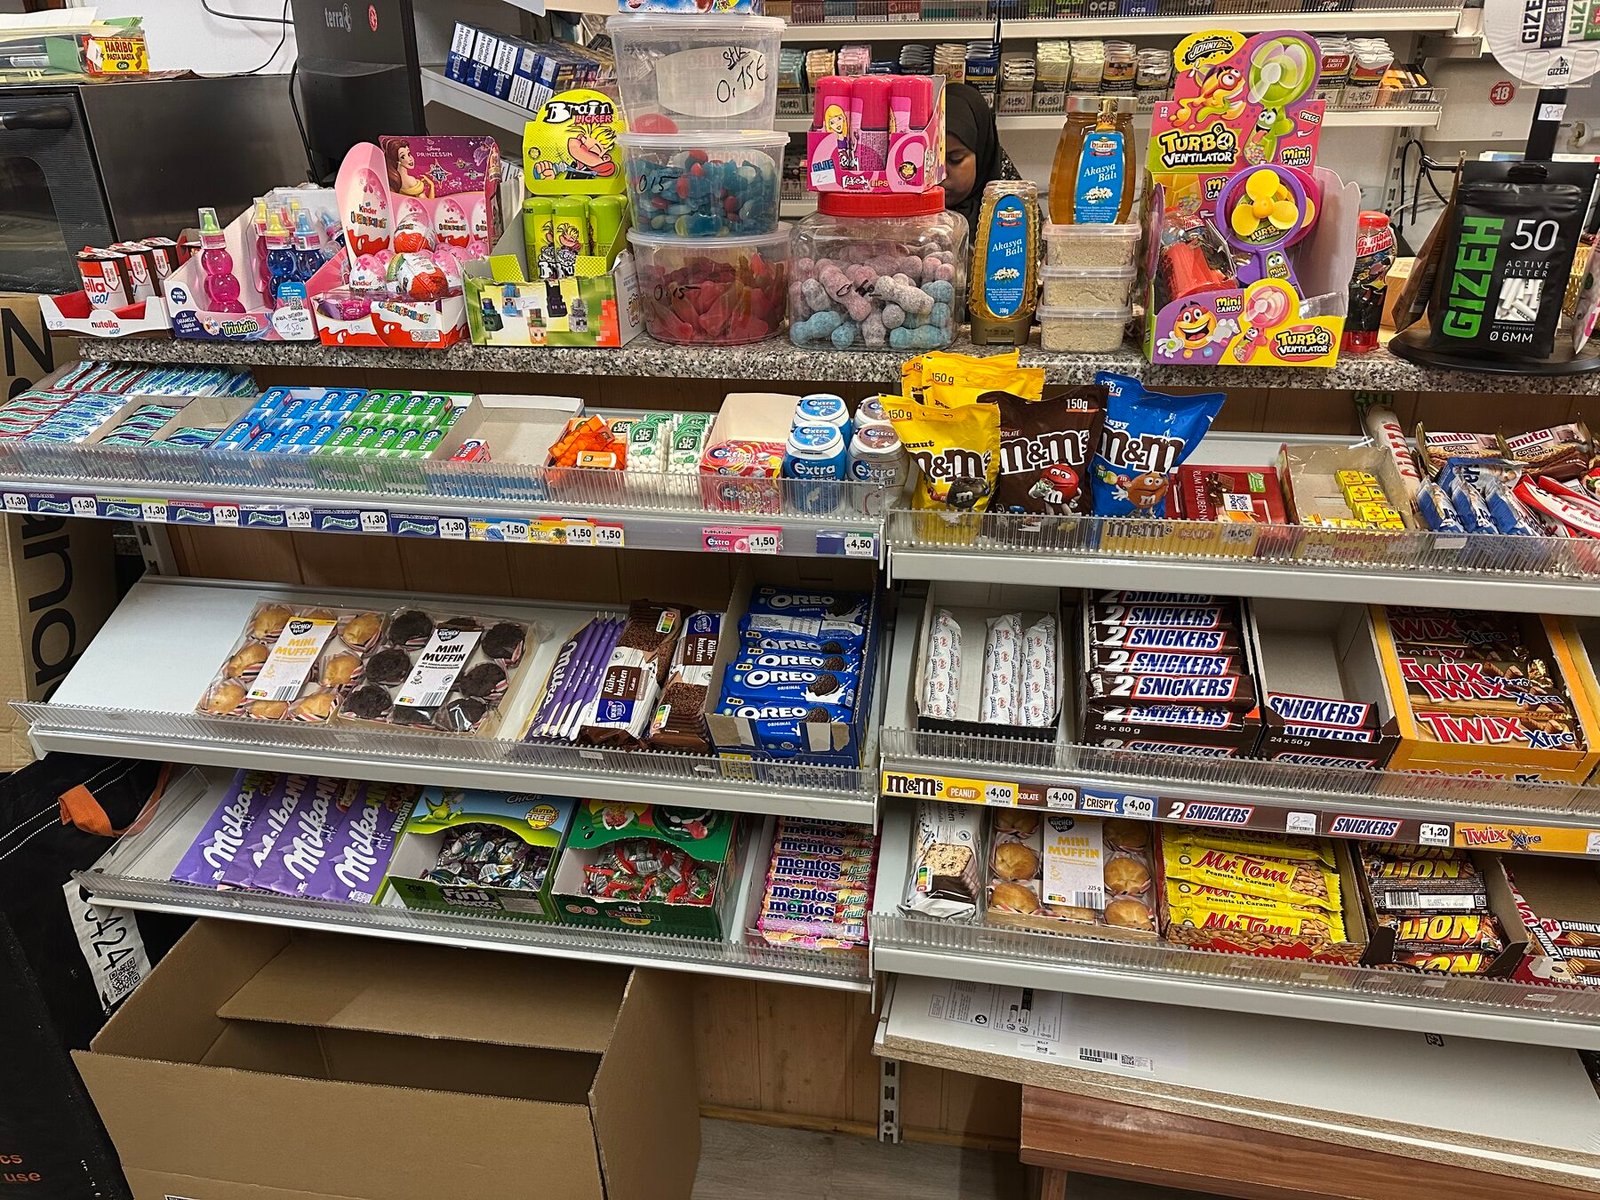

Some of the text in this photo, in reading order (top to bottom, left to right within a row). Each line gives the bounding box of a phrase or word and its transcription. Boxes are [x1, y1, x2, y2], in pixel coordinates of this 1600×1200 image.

[1090, 1, 1117, 12] OCB
[325, 8, 344, 27] terra
[105, 41, 133, 53] HARIBO
[460, 29, 471, 55] Rauchen
[482, 37, 493, 67] Rauchen
[1189, 42, 1218, 61] JOHNY
[503, 47, 514, 76] Rauchen
[1547, 67, 1570, 76] GIZEH
[546, 101, 612, 122] Brain
[1160, 106, 1169, 114] 12
[575, 115, 613, 124] LICKER
[1300, 111, 1321, 125] PRESS
[1160, 122, 1235, 154] TURBO
[1164, 149, 1236, 169] VENTILATOR
[1282, 146, 1311, 161] mini
[1282, 158, 1311, 168] CANDY
[1083, 163, 1117, 179] Akasya
[871, 179, 889, 190] LIPS
[359, 204, 377, 214] Kinder
[1509, 219, 1560, 252] 50
[992, 239, 1022, 253] Akasya
[1269, 265, 1287, 276] mini
[1505, 260, 1552, 269] ACTIVE
[1442, 216, 1505, 339] GIZEH
[1503, 268, 1549, 278] FILTER
[1215, 296, 1242, 309] mini
[1216, 305, 1242, 315] CANDY
[222, 321, 258, 336] Trinketto
[1278, 327, 1330, 348] TURBO
[1501, 331, 1533, 344] 6MM
[1279, 343, 1330, 358] VENTILATOR
[931, 372, 947, 384] 150
[1066, 399, 1089, 413] 150g
[888, 409, 905, 421] 150
[635, 433, 649, 441] tac
[639, 428, 651, 436] tic
[679, 440, 693, 449] tac
[683, 436, 695, 444] tic
[1426, 433, 1476, 446] hanuta
[1508, 429, 1550, 450] anuta
[713, 448, 755, 461] extra
[1000, 430, 1091, 476] m&m's
[1445, 445, 1469, 453] COCOA
[1517, 446, 1542, 457] COCOA
[1526, 449, 1554, 460] CRUNCH
[795, 462, 836, 476] extra
[856, 464, 897, 478] extra
[38, 499, 71, 512] Airwaves
[1195, 485, 1208, 512] TRAUBEN
[106, 503, 142, 517] Airwaves
[177, 508, 212, 522] Airwaves
[248, 511, 284, 526] Airwaves
[322, 514, 360, 530] Airwaves
[398, 521, 438, 535] Airwaves
[705, 536, 730, 547] extra
[769, 594, 835, 609] OREO
[1101, 604, 1219, 628] 2 SNICKERS
[287, 638, 316, 646] MINI
[1103, 626, 1222, 648] 2 SNICKERS
[274, 647, 318, 656] MUFFIN
[435, 644, 464, 653] MINI
[696, 636, 708, 663] kuchen
[707, 639, 718, 661] Rühr-
[759, 638, 821, 652] OREO
[422, 653, 466, 663] MUFFIN
[757, 654, 825, 667] OREO
[1105, 650, 1228, 675] 2 SNICKERS
[603, 671, 617, 694] Rühr-
[613, 669, 629, 697] kuchen
[745, 669, 818, 687] OREO
[1109, 675, 1233, 697] 2 SNICKERS
[736, 706, 809, 721] OREO
[1102, 706, 1127, 721] 2
[1268, 697, 1365, 726] SNICKERS
[1523, 730, 1577, 750] Xtra
[886, 775, 944, 797] m&m's
[950, 788, 976, 798] PEANUT
[1086, 797, 1115, 810] CRISPY
[525, 812, 551, 822] FREE
[1166, 802, 1251, 824] 2 SNICKERS
[203, 789, 254, 870] Milka
[1333, 817, 1400, 837] SNICKERS
[283, 793, 333, 881] Milka
[1057, 836, 1090, 847] MINI
[1511, 830, 1542, 845] Xtra
[335, 804, 380, 889] Milka
[780, 840, 873, 858] mentos fruit
[1048, 846, 1100, 859] MUFFIN
[776, 857, 871, 876] mentos fruit
[1234, 854, 1291, 885] Tom
[1205, 869, 1276, 888] Peanuts Caramel
[443, 888, 490, 901] Fini
[771, 885, 868, 906] mentos fruit
[769, 899, 866, 920] mentos fruit
[1206, 896, 1277, 909] Peanuts Caramel
[1237, 914, 1294, 936] Tom
[1532, 926, 1563, 961] CHUNKY
[4, 1171, 41, 1183] use
